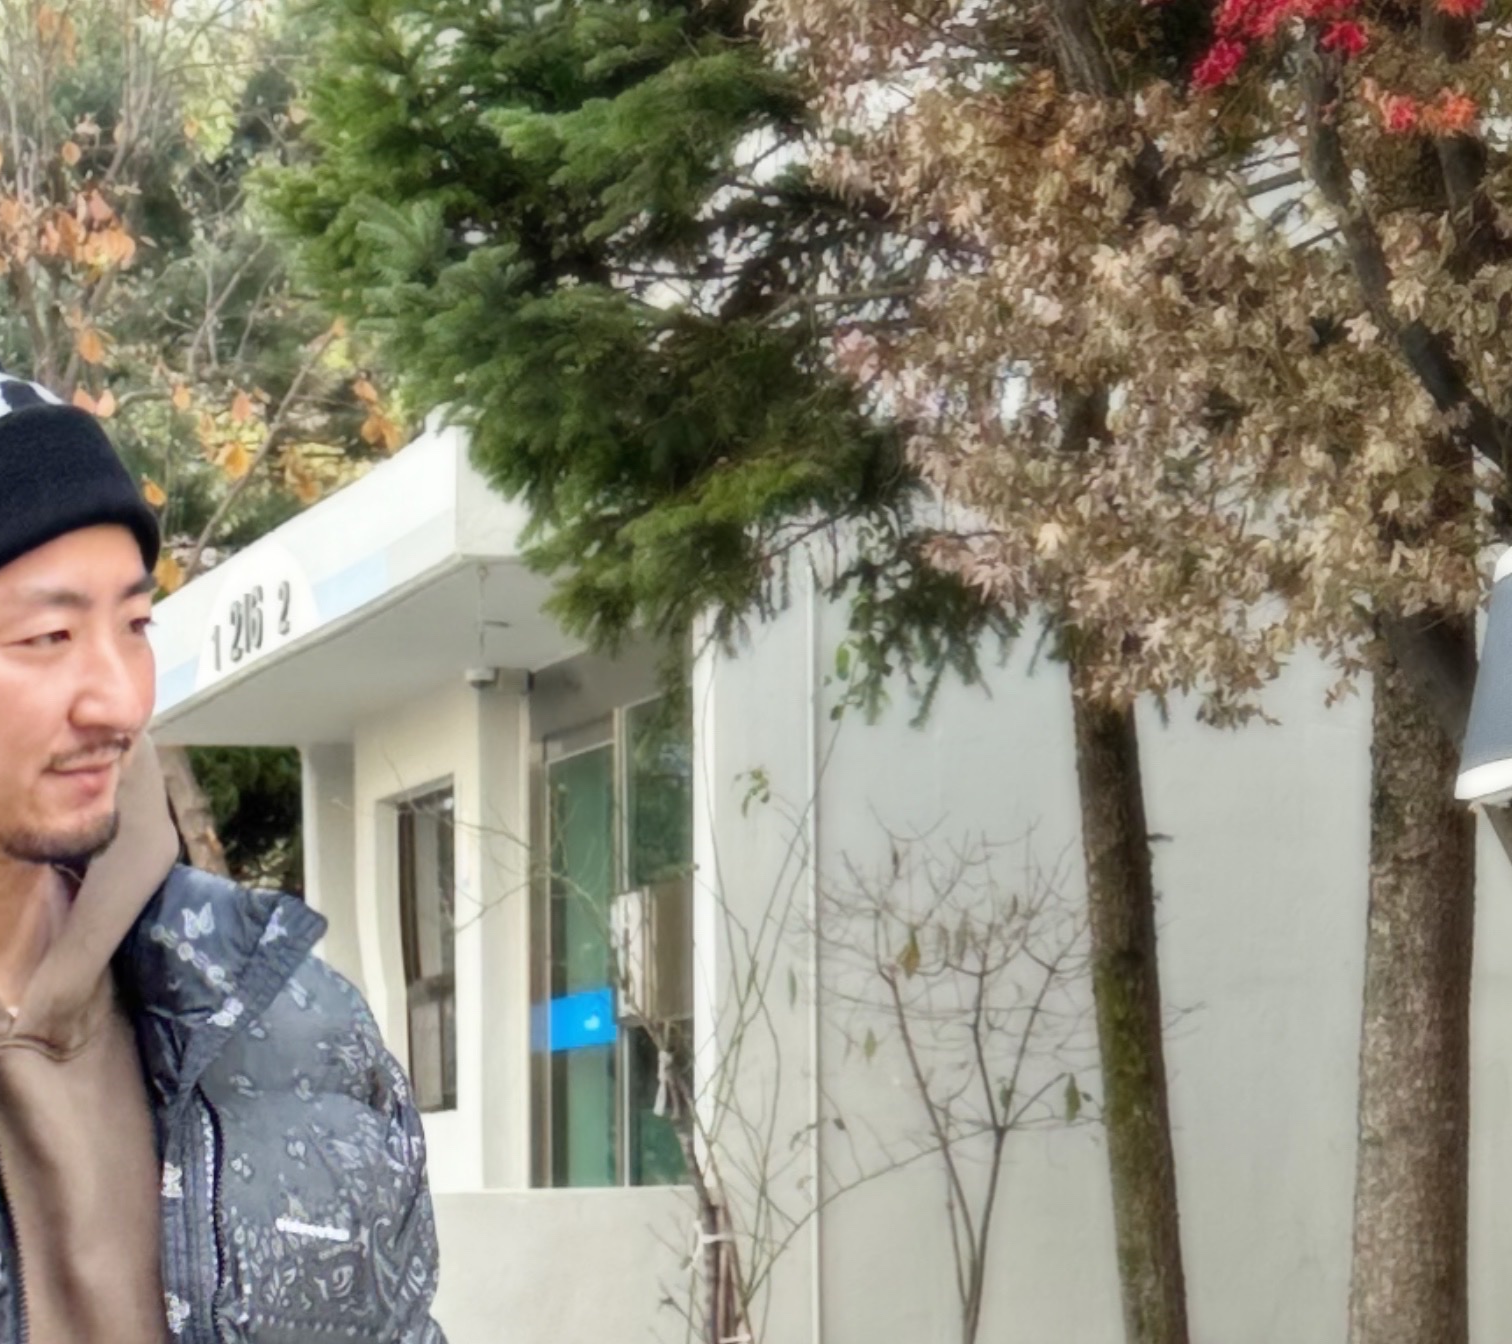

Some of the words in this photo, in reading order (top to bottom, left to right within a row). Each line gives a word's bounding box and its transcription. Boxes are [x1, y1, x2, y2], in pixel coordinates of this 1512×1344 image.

[210, 624, 222, 672] 1
[230, 585, 264, 663] 216
[278, 580, 291, 636] 2
